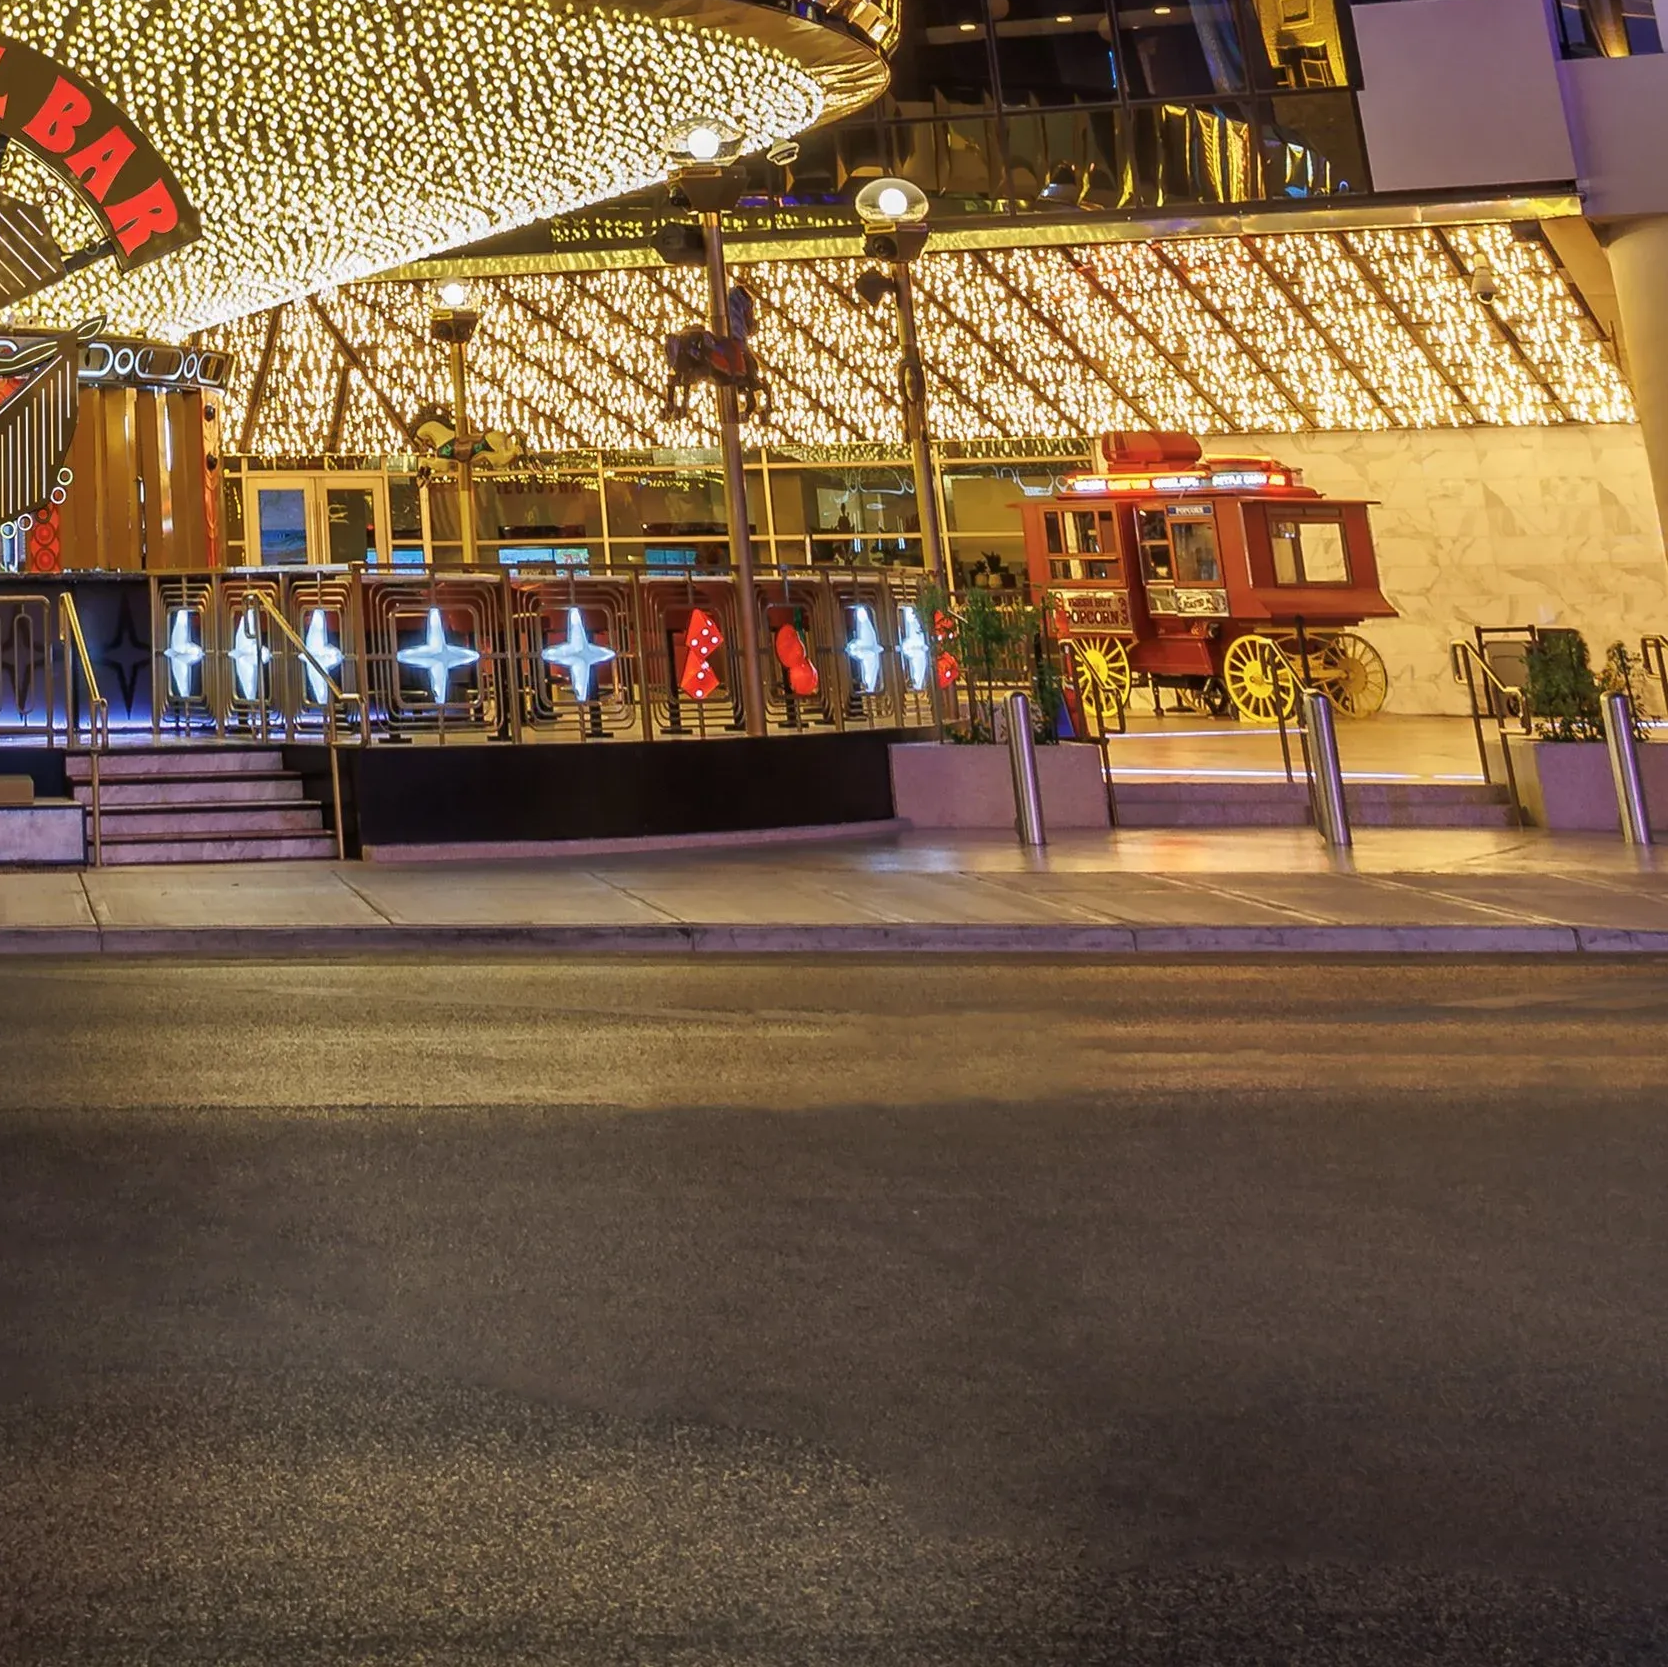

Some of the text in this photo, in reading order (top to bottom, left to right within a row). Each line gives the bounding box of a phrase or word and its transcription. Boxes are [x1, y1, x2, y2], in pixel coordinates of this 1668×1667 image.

[22, 74, 179, 259] BAR
[1094, 597, 1112, 607] HOT
[1065, 610, 1120, 624] POPCORN
